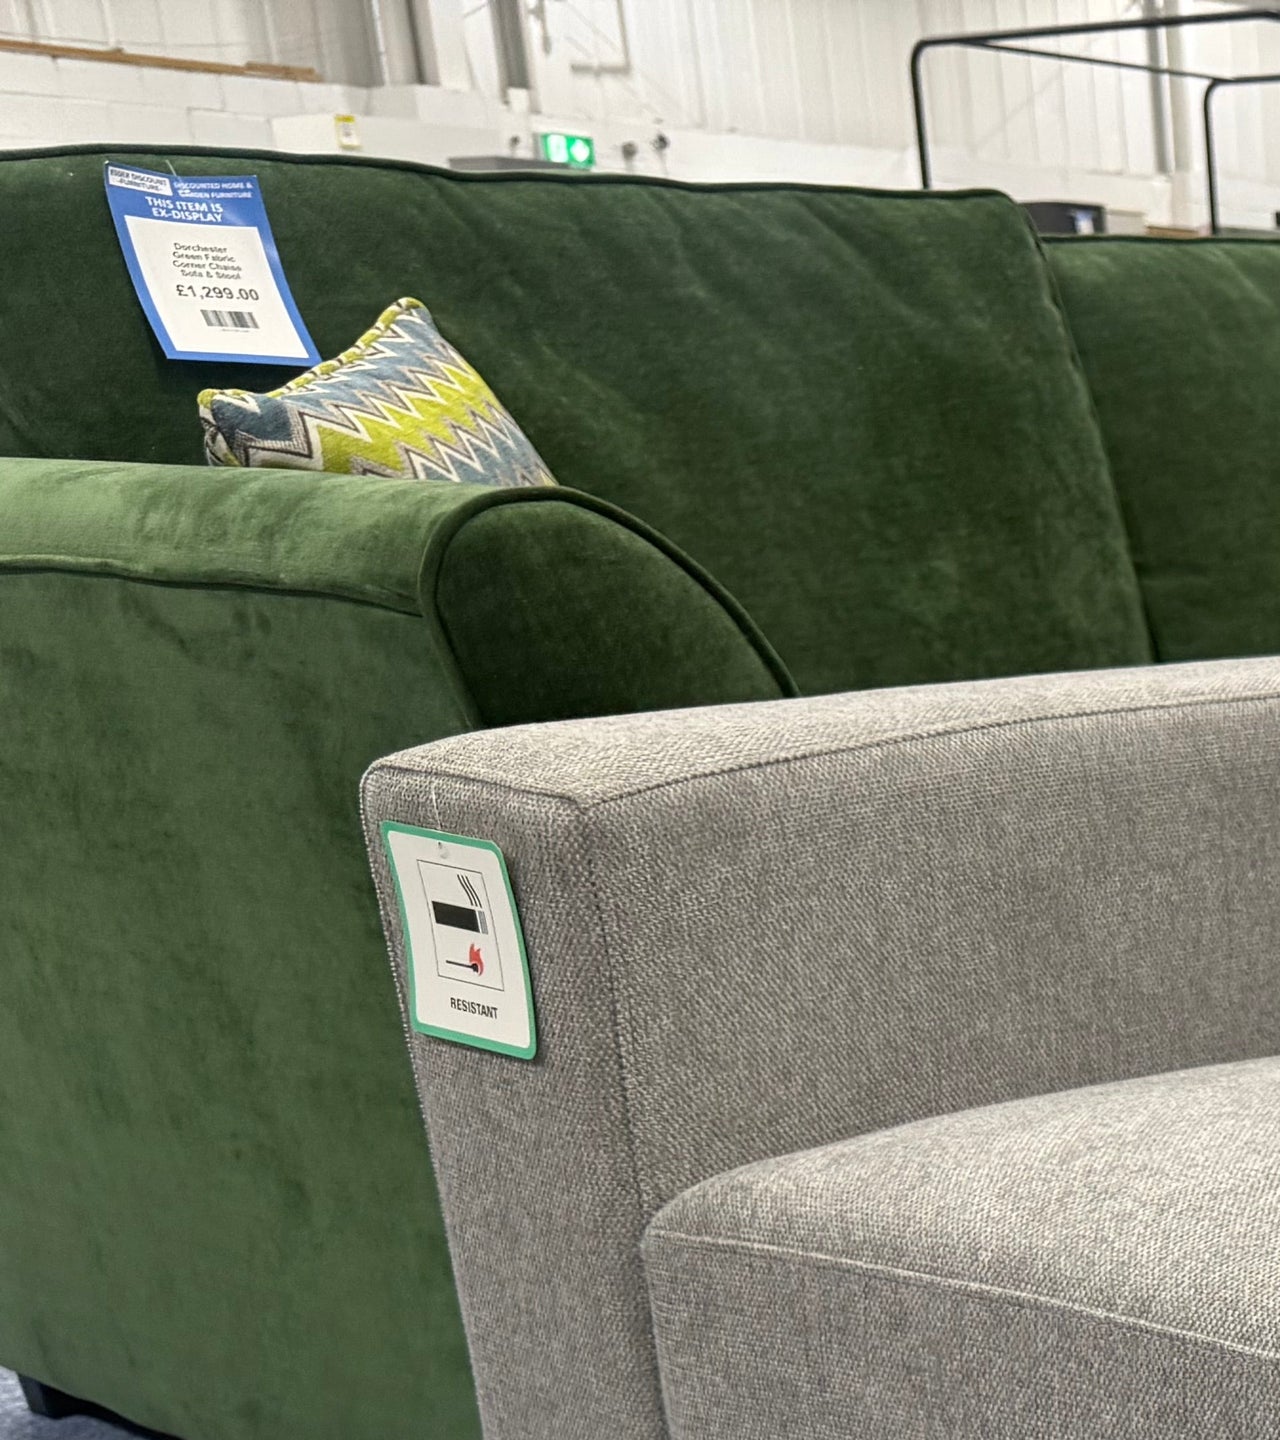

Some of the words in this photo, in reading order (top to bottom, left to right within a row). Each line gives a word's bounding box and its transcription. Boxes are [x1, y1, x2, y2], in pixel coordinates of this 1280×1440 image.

[131, 173, 167, 186] DISCOUNT
[173, 181, 221, 190] DISCOUNTED
[221, 182, 245, 190] HOME
[145, 196, 174, 209] THIS
[175, 201, 209, 213] ITEM
[210, 203, 224, 214] IS
[151, 207, 223, 223] EX-DISPLAY
[173, 242, 228, 254] Dorchester
[172, 251, 203, 261] Green
[204, 253, 237, 263] Fabric
[172, 260, 206, 270] Corner
[176, 284, 260, 301] £1,299.00
[450, 997, 499, 1020] RESISTANT
